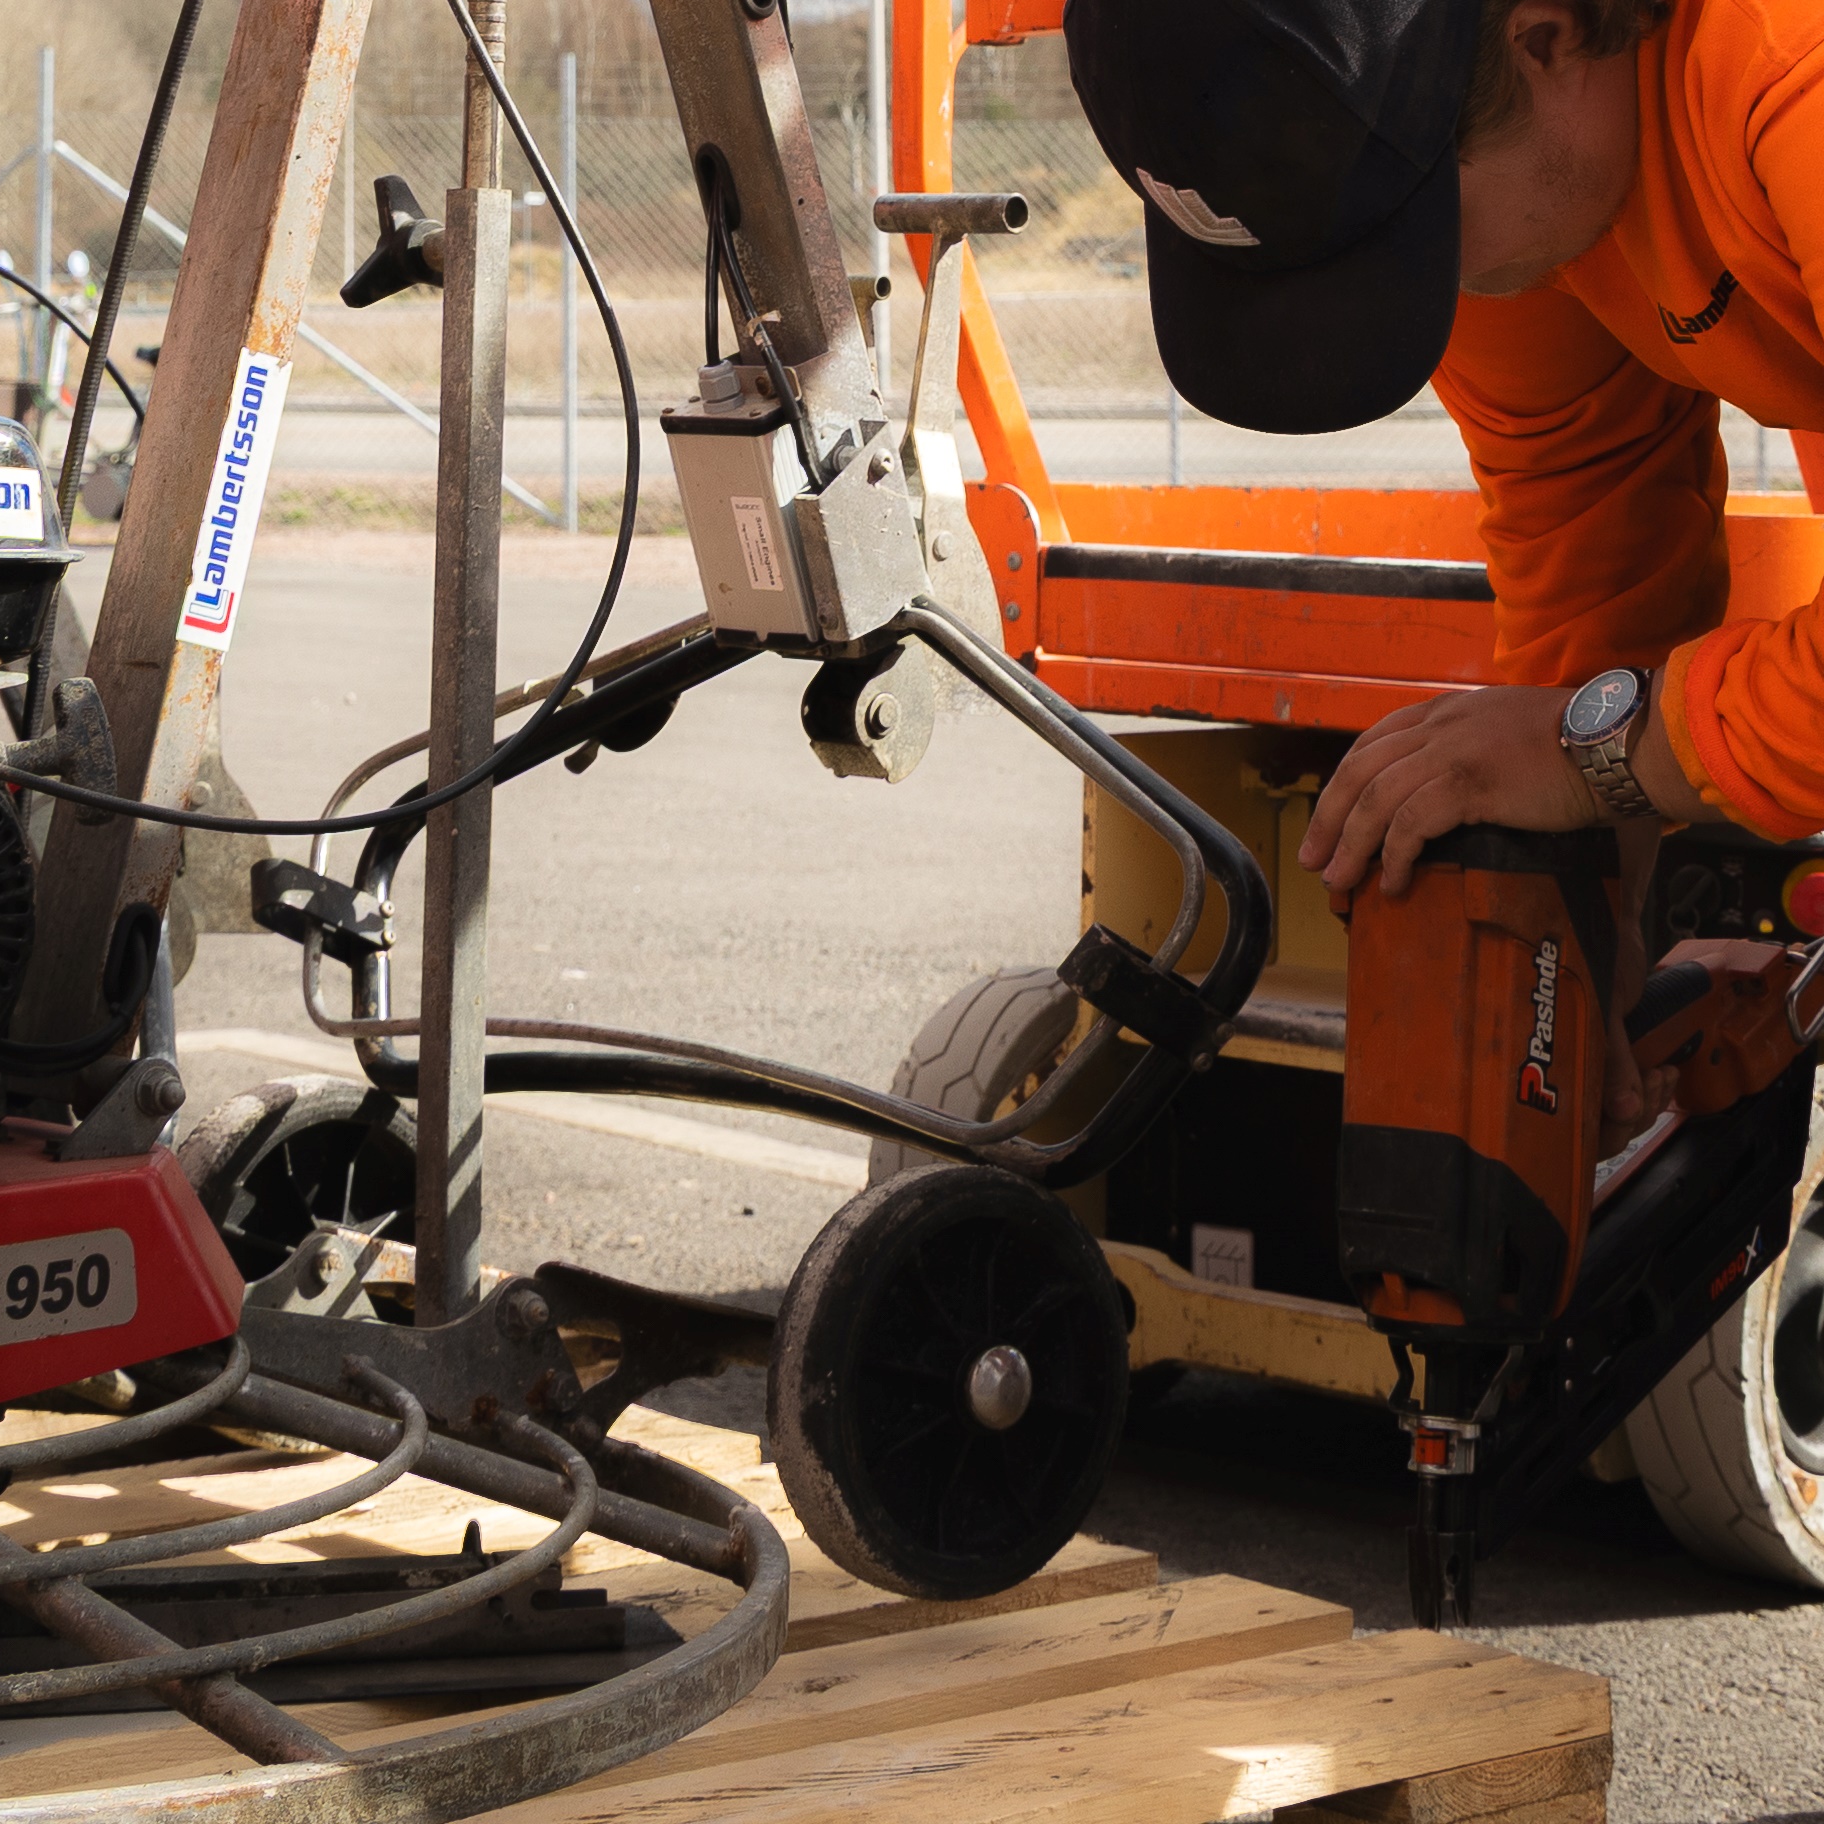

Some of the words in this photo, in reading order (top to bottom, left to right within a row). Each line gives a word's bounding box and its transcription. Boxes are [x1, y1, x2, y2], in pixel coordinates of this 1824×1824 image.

[190, 363, 269, 606] Lambertsson
[1529, 940, 1558, 1065] Paslode
[4, 1252, 112, 1321] 950
